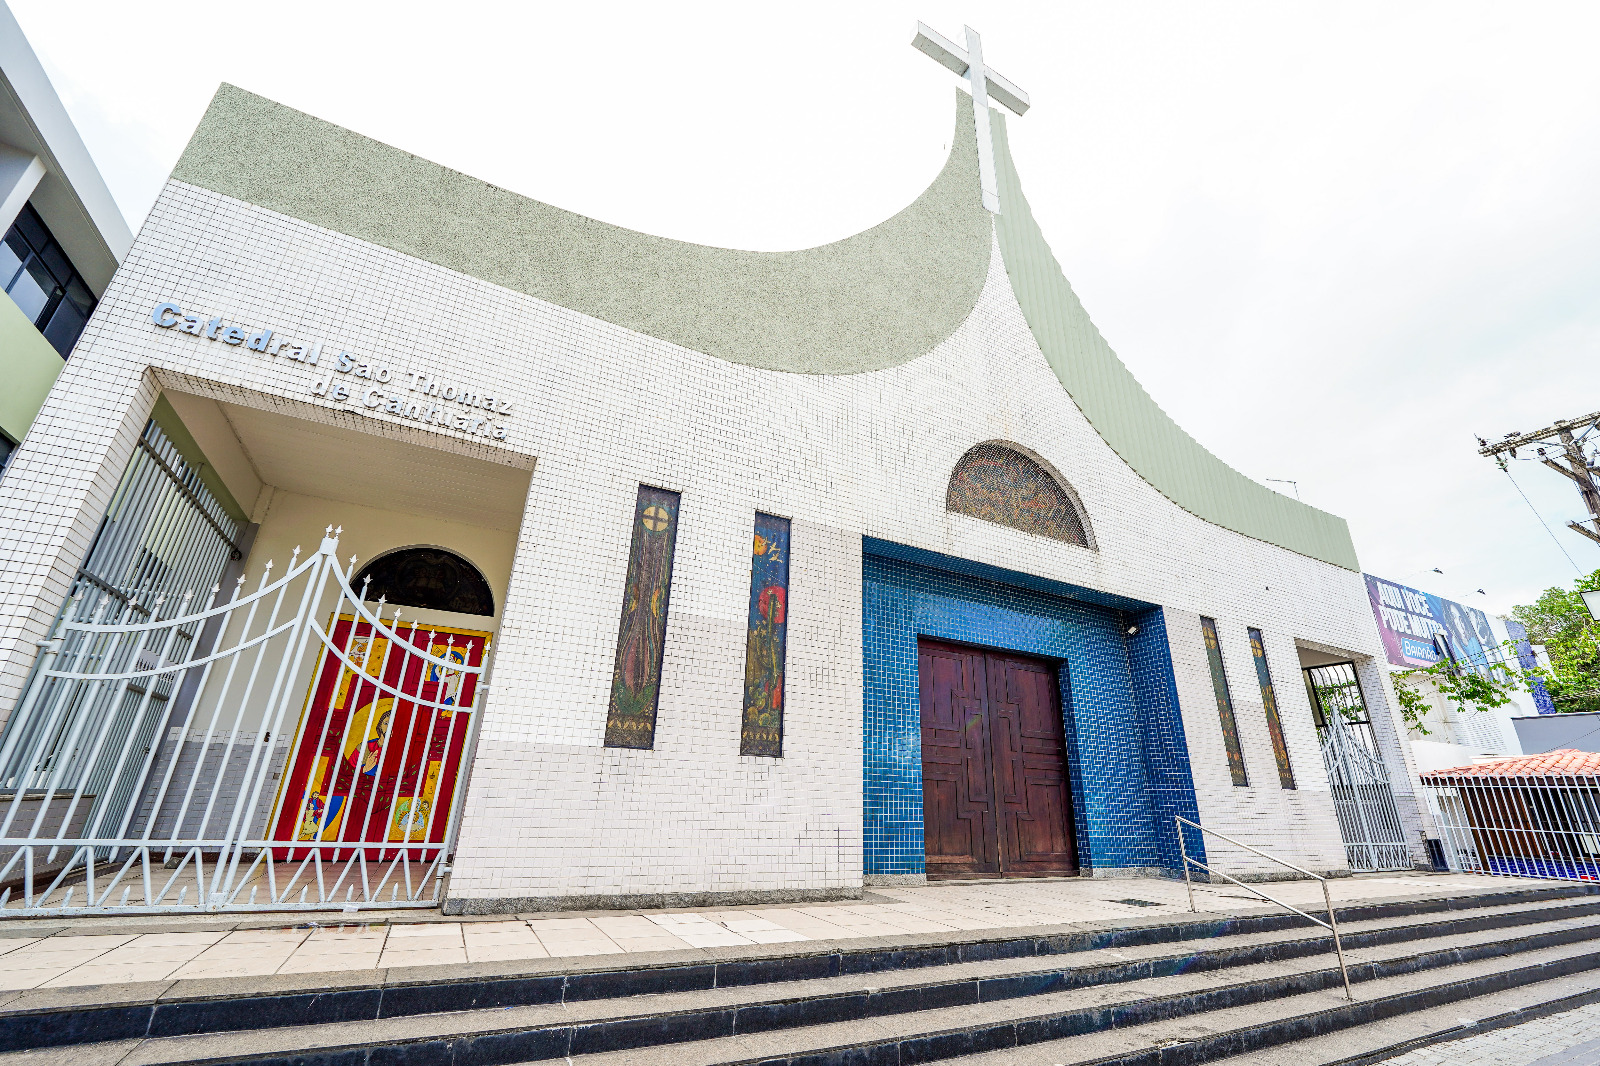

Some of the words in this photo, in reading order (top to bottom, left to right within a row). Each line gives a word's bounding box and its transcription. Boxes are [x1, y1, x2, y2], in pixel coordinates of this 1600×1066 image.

[152, 302, 323, 366] Catedral
[408, 370, 514, 416] Thomaz
[310, 373, 350, 402] de
[1377, 581, 1405, 610] AQUI
[1378, 605, 1412, 635] PODE
